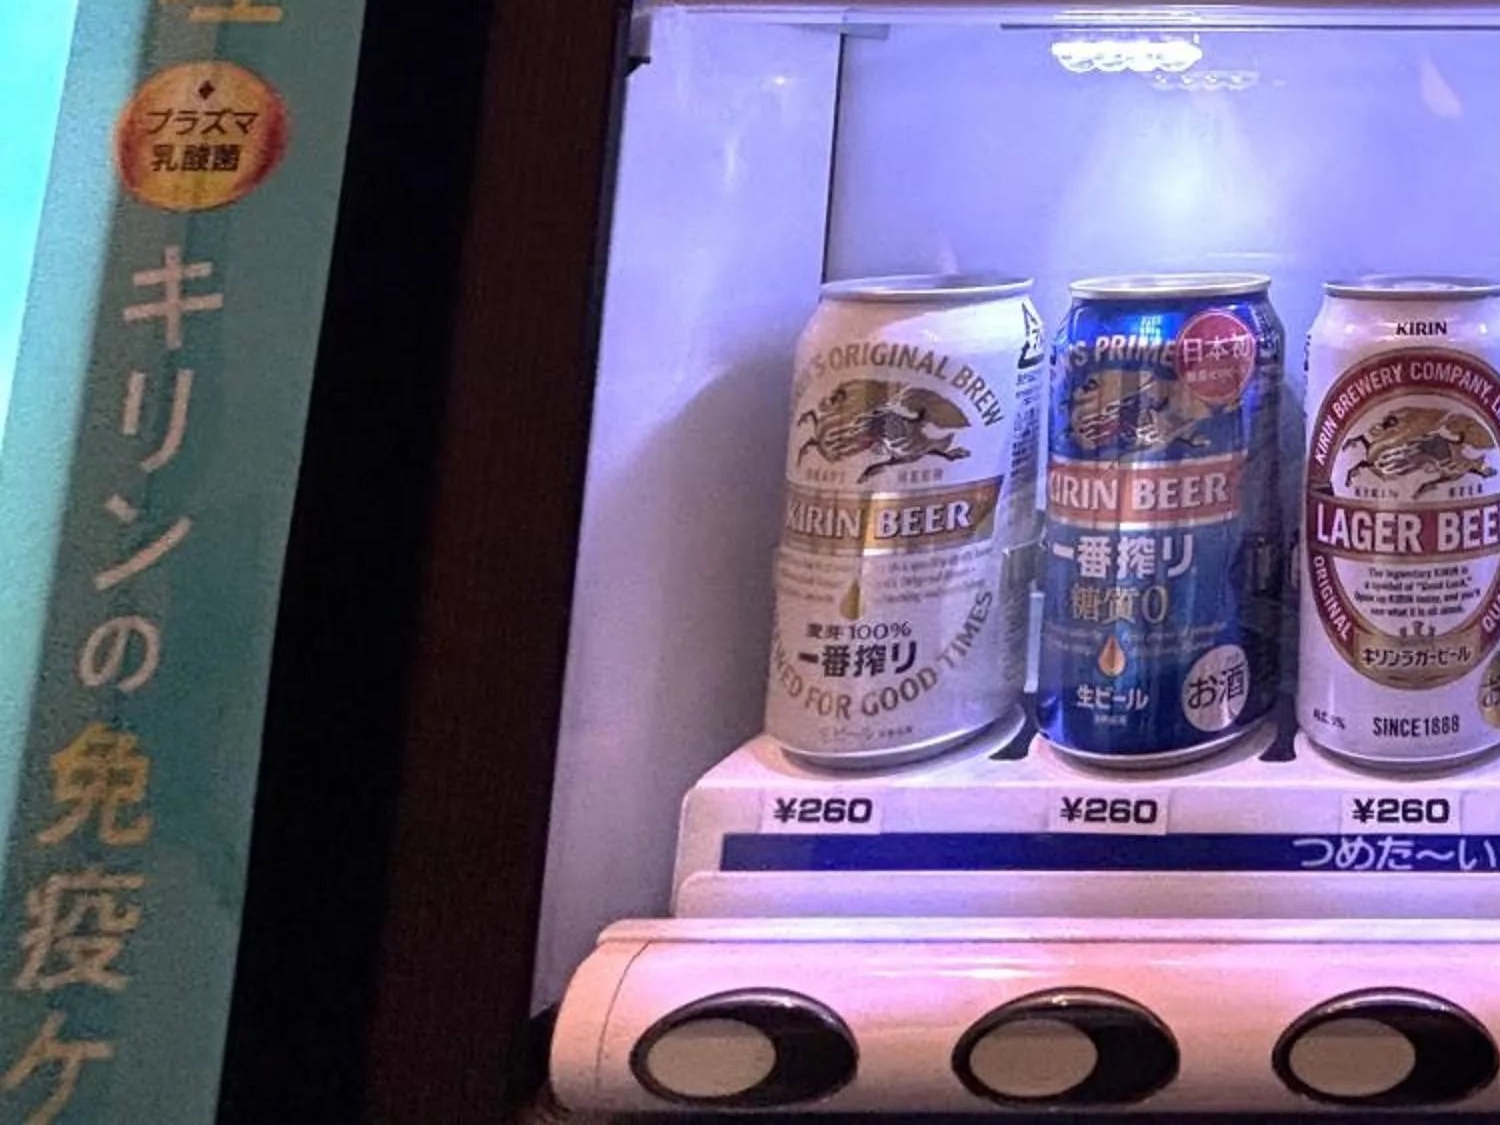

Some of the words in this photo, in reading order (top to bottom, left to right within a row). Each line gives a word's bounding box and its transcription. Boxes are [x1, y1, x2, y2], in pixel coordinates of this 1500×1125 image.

[145, 108, 259, 135] プラズマ
[150, 143, 241, 173] 乳酸菌
[1395, 321, 1448, 336] KIRIN
[1093, 334, 1176, 368] PRIME
[828, 341, 949, 380] ORIGINAL
[952, 364, 1004, 427] BREW
[1314, 415, 1339, 465] KIRIN
[1332, 363, 1403, 418] BREWERY
[1051, 470, 1119, 510] IRIN
[1131, 471, 1230, 511] BEER
[874, 500, 974, 539] BEER
[1316, 502, 1424, 553] LAGER
[1053, 534, 1194, 579] 一番搾り
[1312, 555, 1354, 641] ORIGINAL
[799, 641, 918, 677] 一番搾り
[805, 687, 851, 720] FOR
[861, 666, 939, 718] GOOD
[939, 589, 994, 669] TIMES
[1361, 645, 1472, 667] キリンラガービール
[1076, 684, 1149, 711] 生ビール
[1187, 665, 1246, 710] お酒
[1372, 716, 1421, 737] SINCE
[773, 797, 873, 824] ¥260
[1060, 796, 1158, 824] ¥260
[1352, 797, 1450, 824] ¥260
